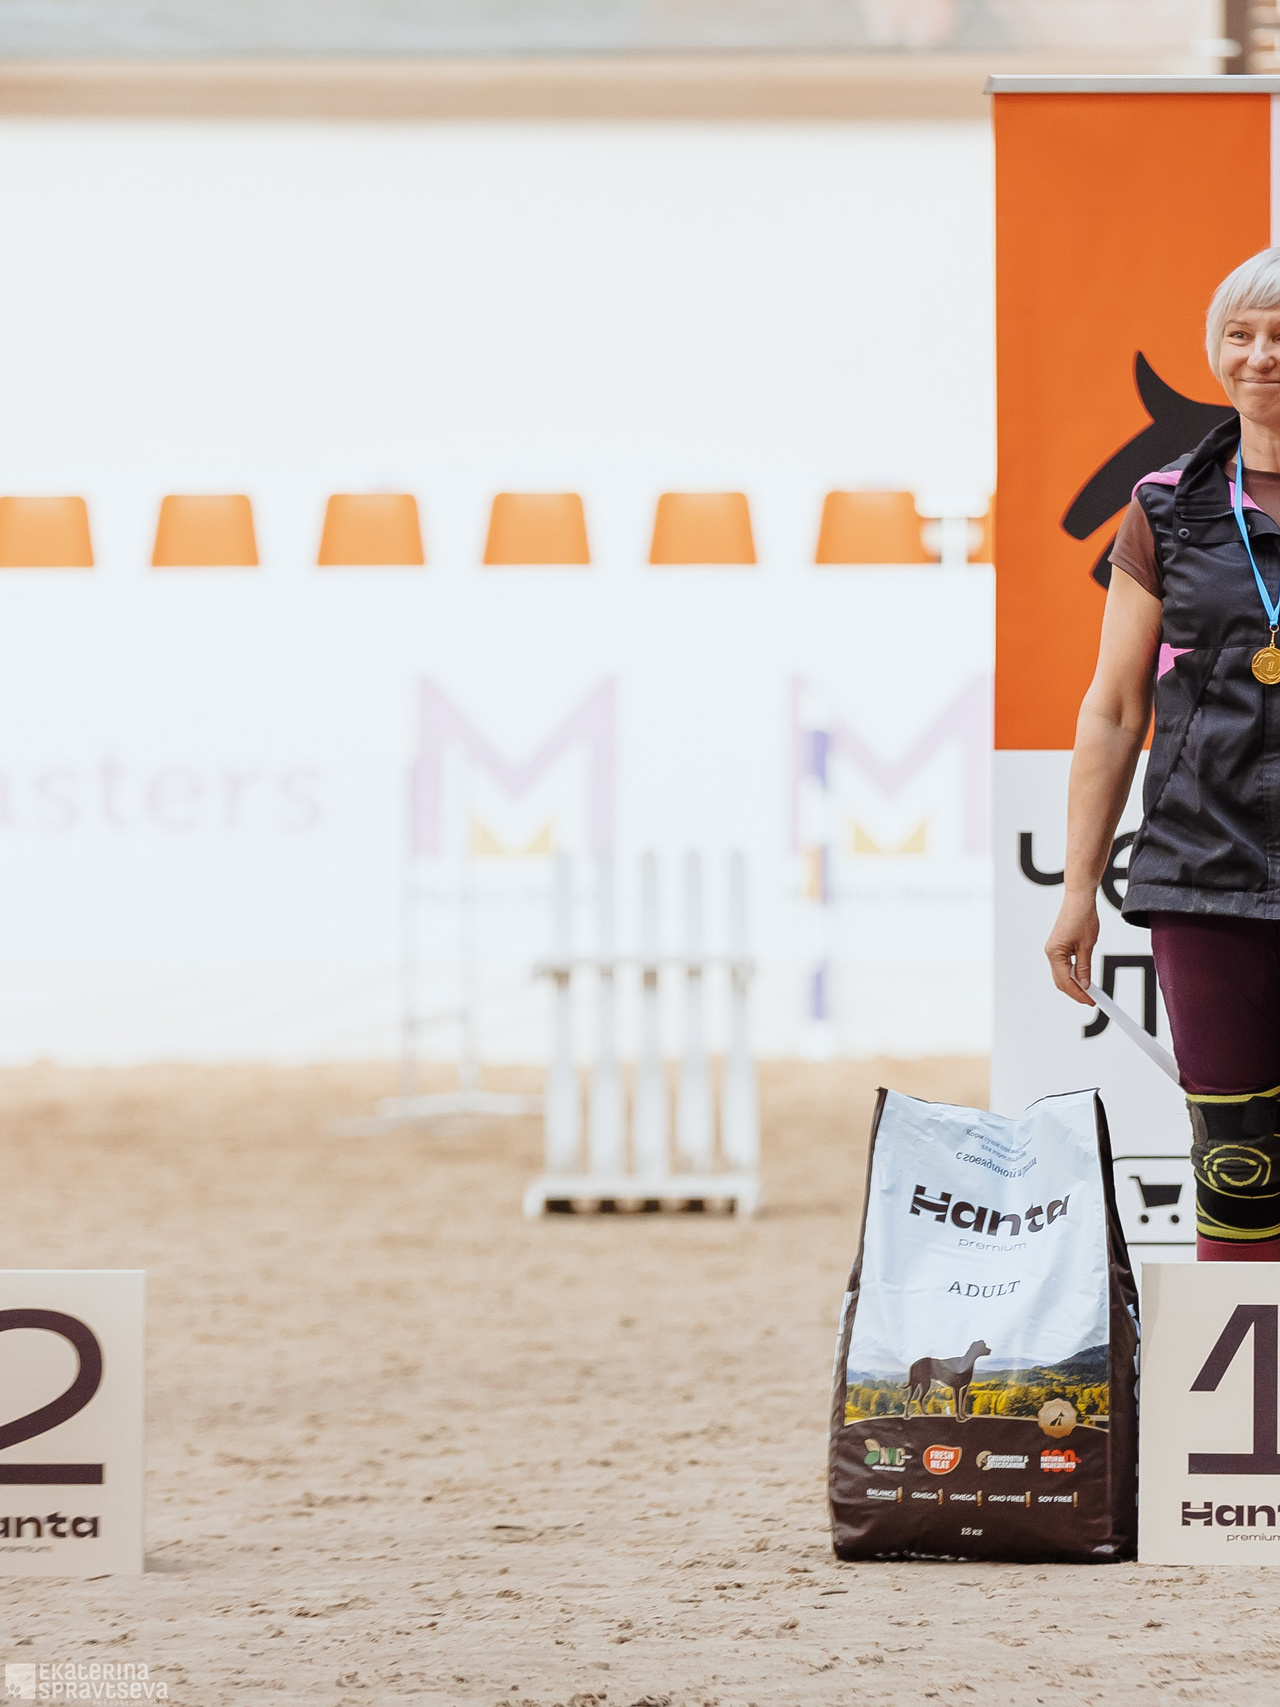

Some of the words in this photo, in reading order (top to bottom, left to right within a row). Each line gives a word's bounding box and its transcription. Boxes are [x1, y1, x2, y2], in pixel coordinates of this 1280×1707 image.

[909, 1184, 1072, 1236] Hanta
[957, 1238, 1028, 1252] premium
[946, 1280, 1021, 1299] ADULT
[0, 1309, 103, 1485] 2
[0, 1511, 101, 1538] nta
[960, 1527, 972, 1536] 12
